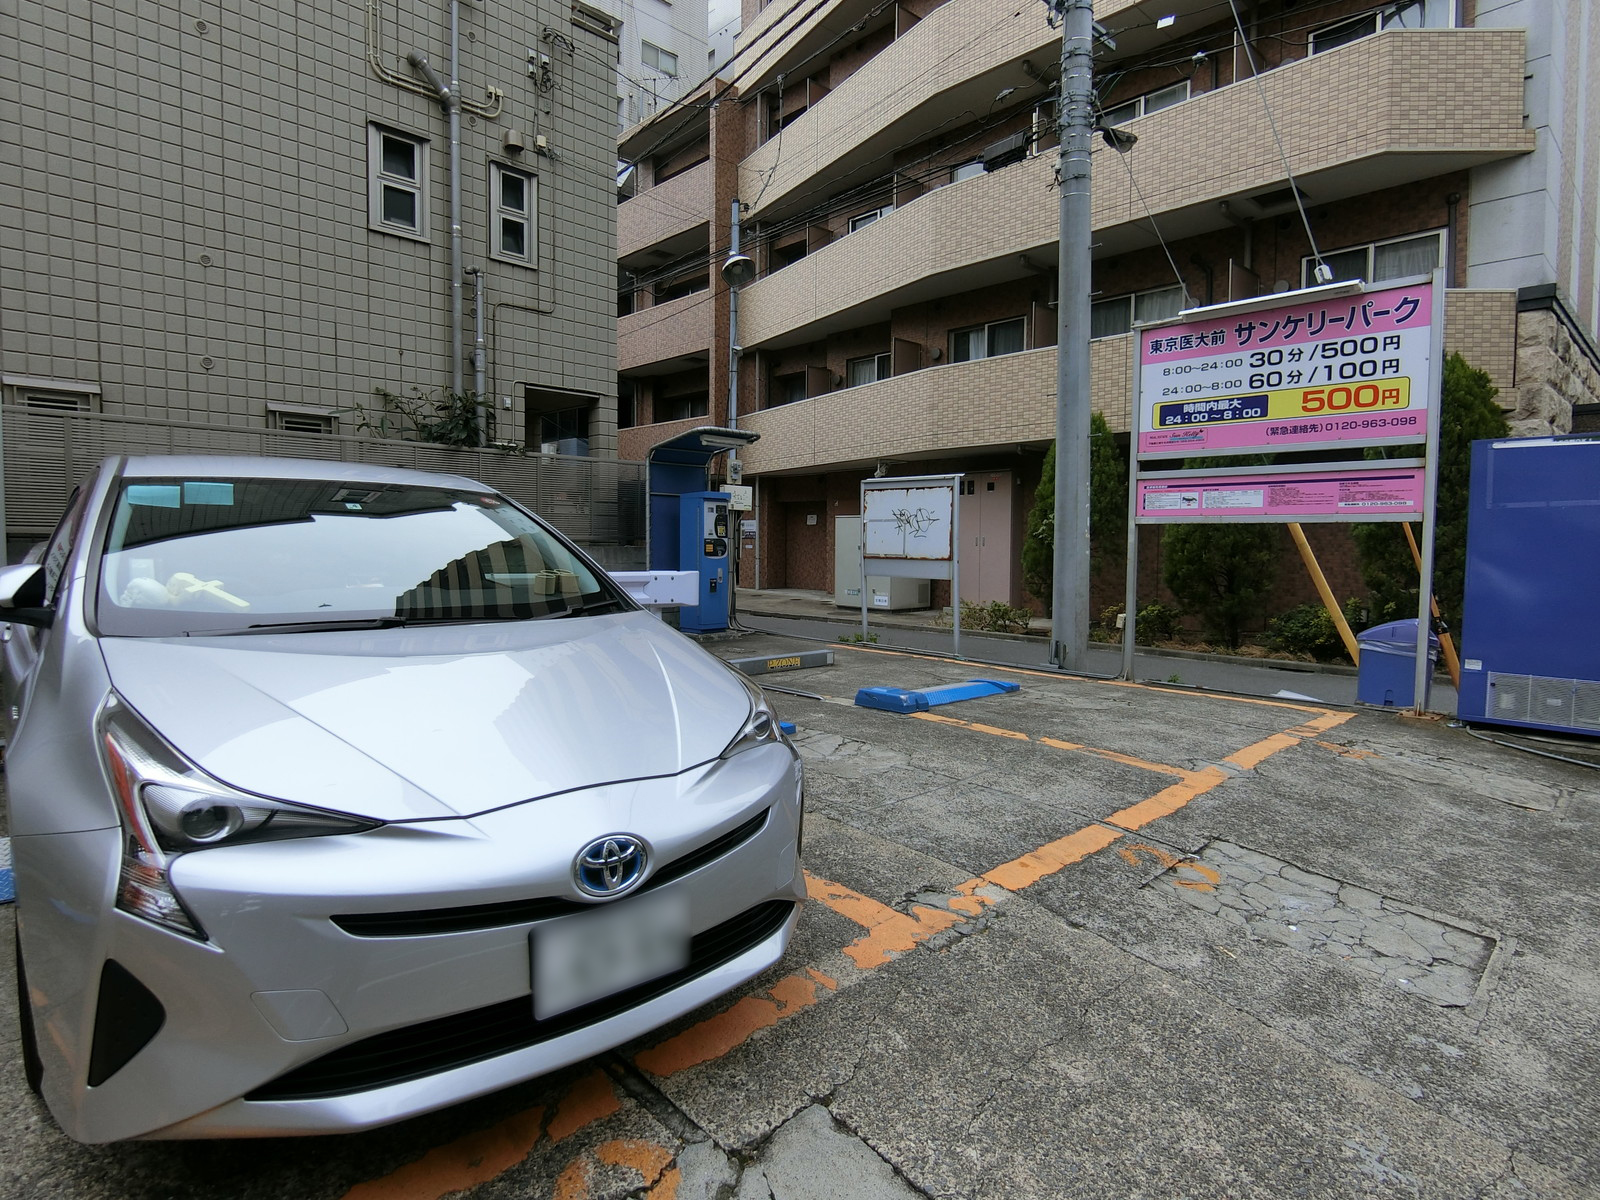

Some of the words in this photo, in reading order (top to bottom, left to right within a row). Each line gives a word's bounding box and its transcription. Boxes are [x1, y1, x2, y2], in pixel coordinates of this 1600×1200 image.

[1150, 330, 1226, 354] 東京医大前
[1235, 297, 1420, 345] サンケリーパーク
[1183, 399, 1242, 413] 時間内最大
[1301, 384, 1400, 412] 500円
